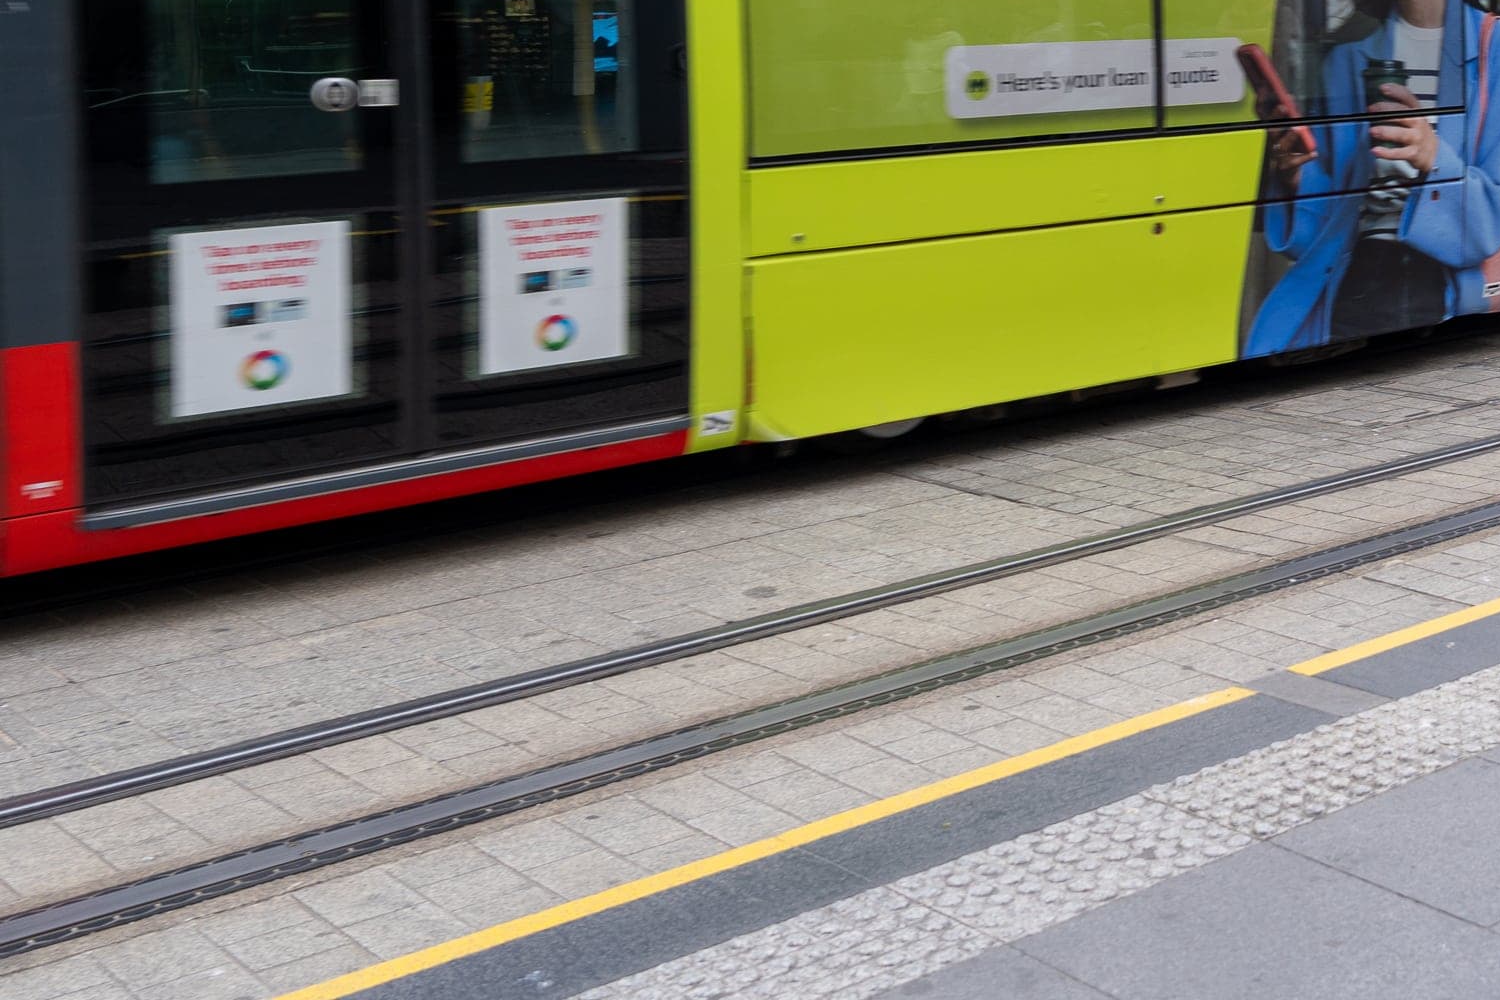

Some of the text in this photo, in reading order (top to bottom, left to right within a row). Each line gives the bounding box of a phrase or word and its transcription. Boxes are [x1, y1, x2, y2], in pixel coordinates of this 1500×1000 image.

[996, 71, 1061, 93] Here's
[1061, 73, 1106, 94] your
[1107, 67, 1148, 87] loan
[1168, 66, 1219, 90] quote
